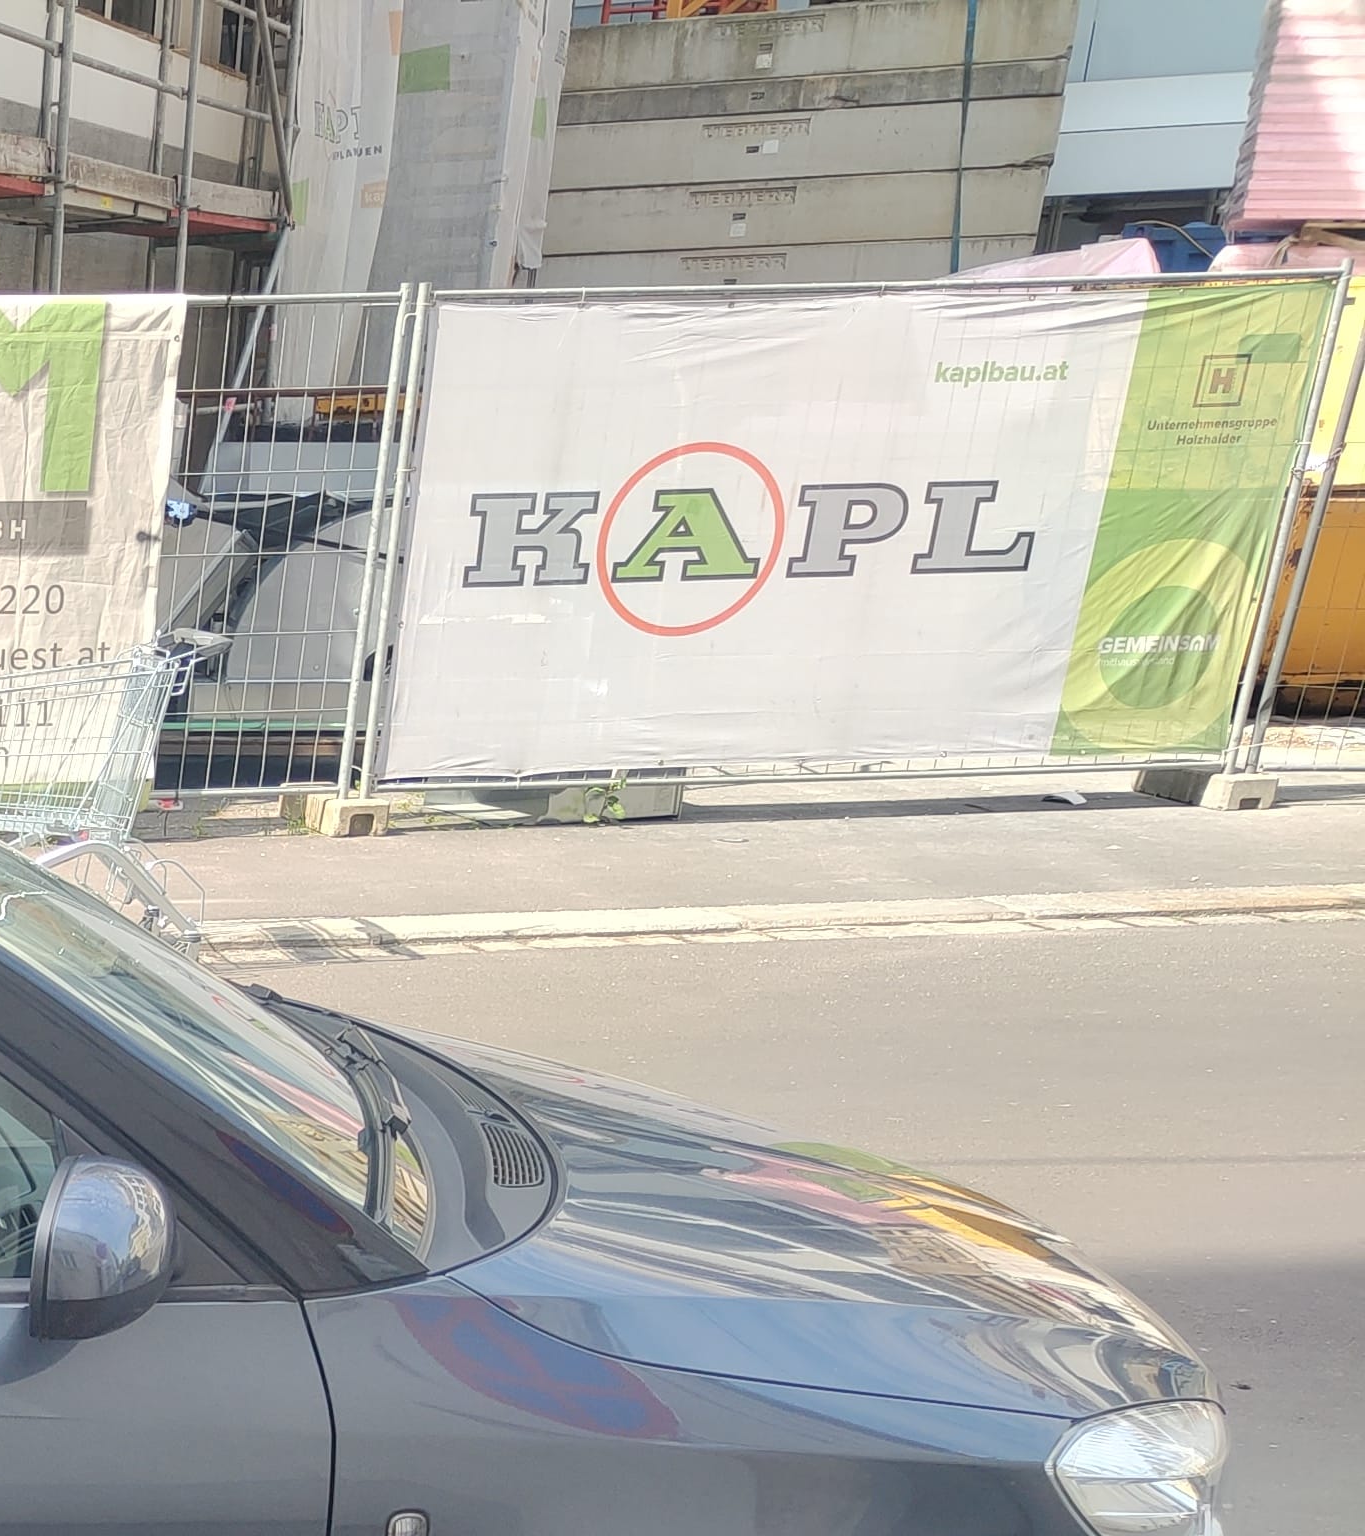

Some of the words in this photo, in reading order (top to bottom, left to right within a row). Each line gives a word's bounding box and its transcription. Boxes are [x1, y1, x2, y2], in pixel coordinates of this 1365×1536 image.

[934, 360, 1069, 388] kaplbau.at
[1147, 417, 1278, 431] Unternehmensgruppe
[461, 479, 1036, 589] KAPL
